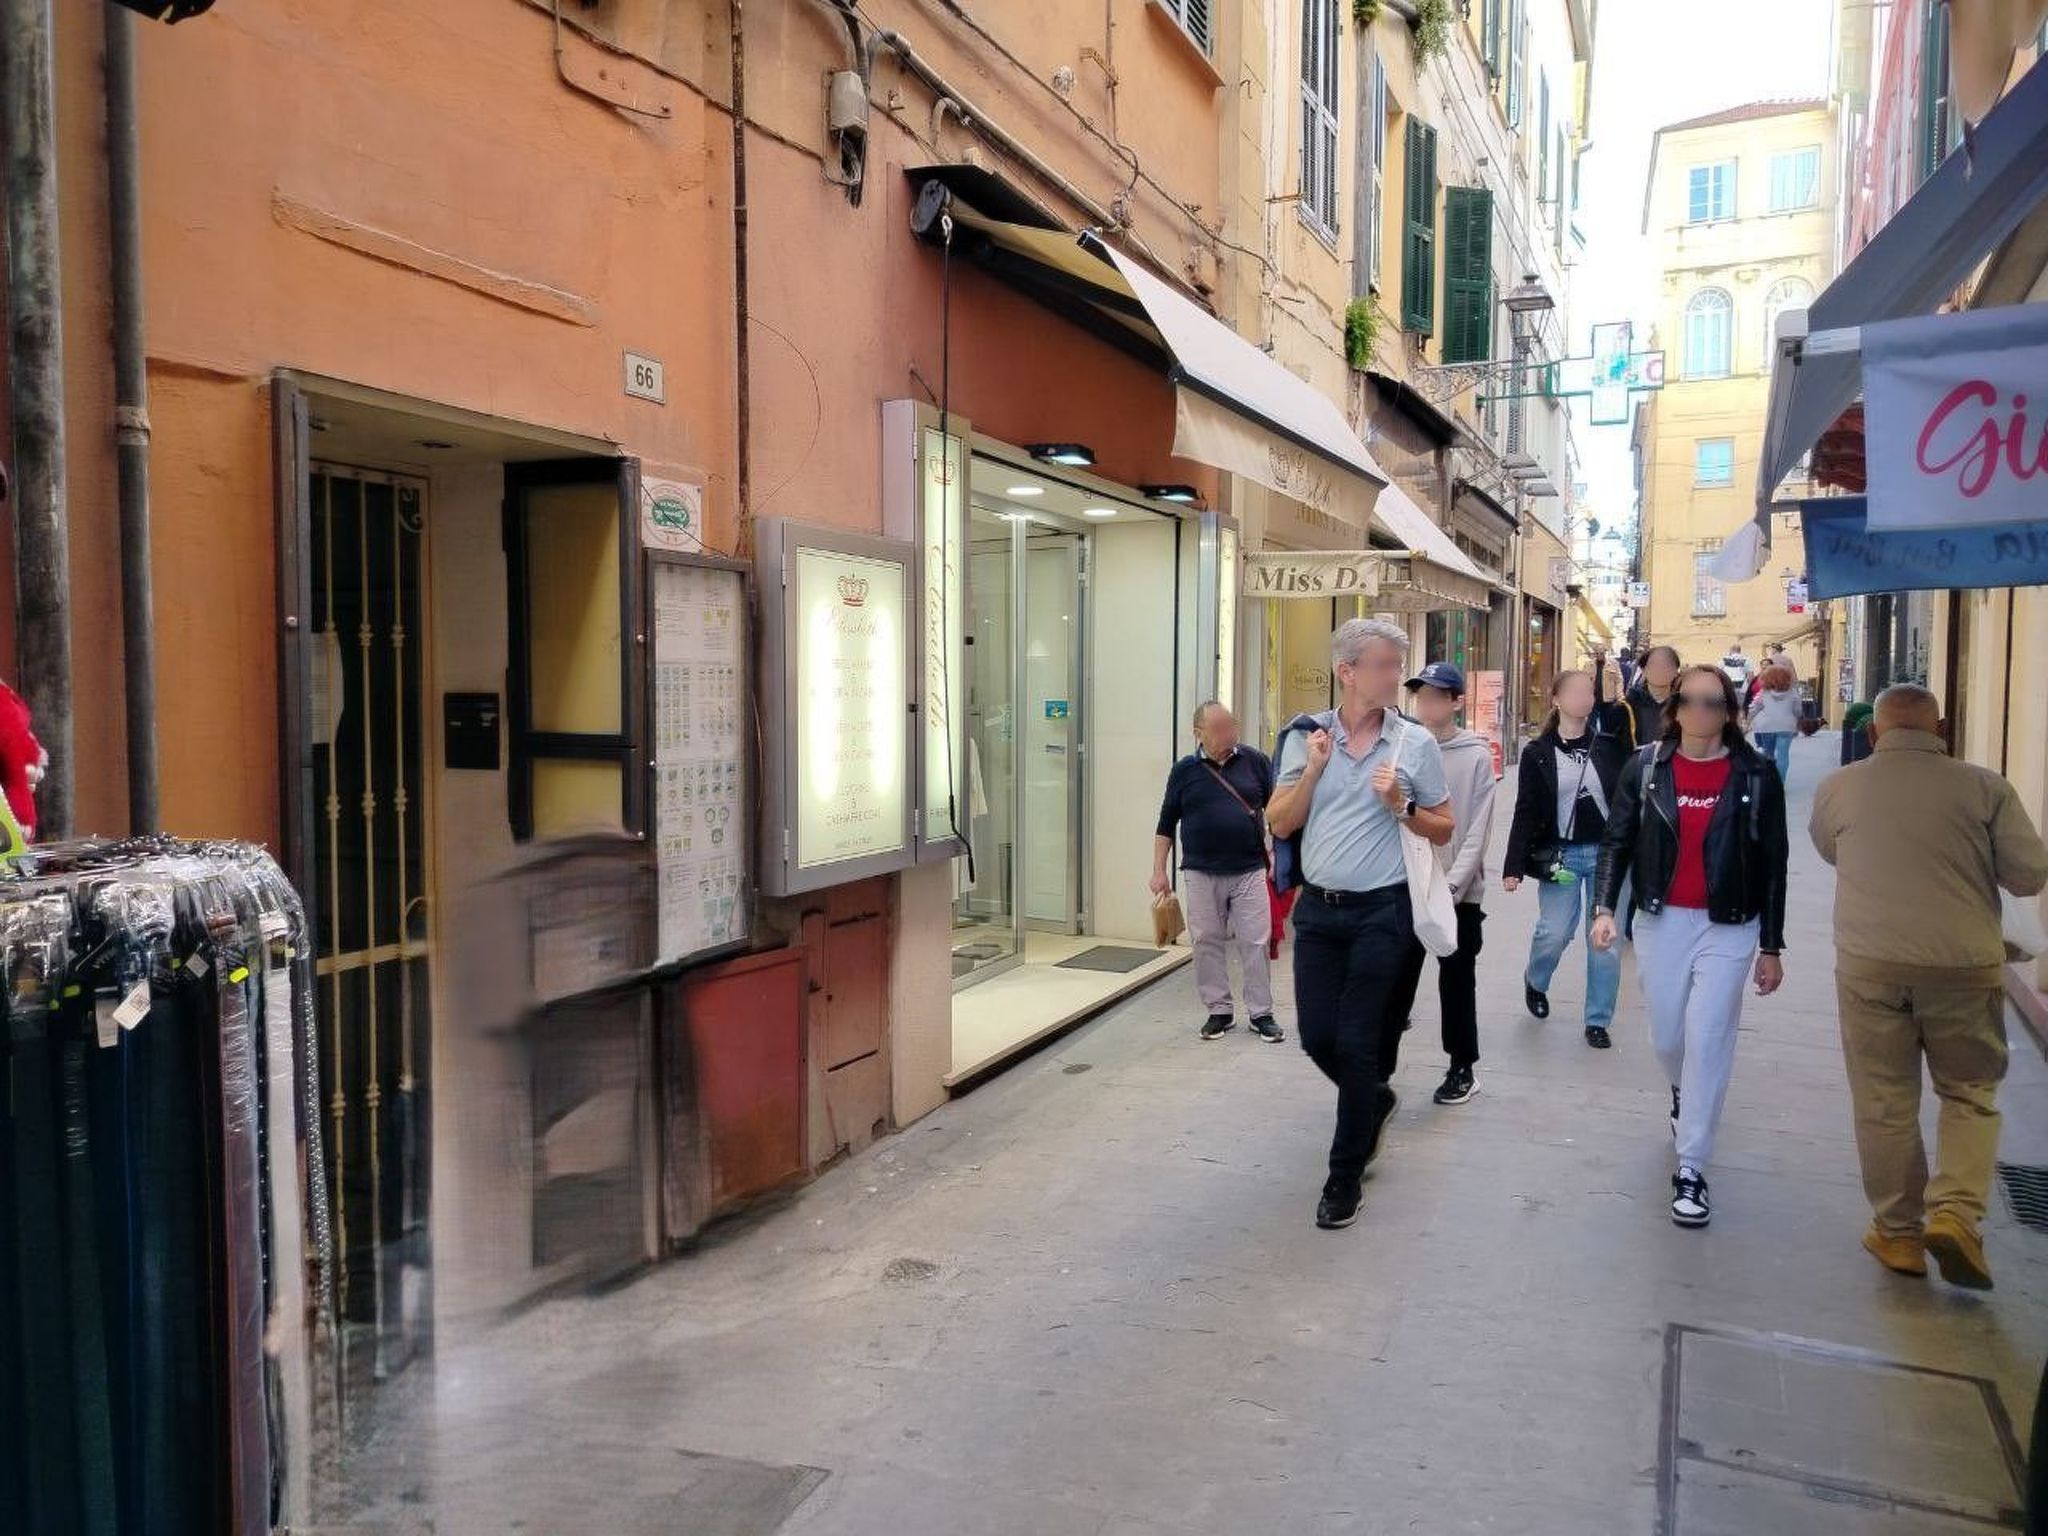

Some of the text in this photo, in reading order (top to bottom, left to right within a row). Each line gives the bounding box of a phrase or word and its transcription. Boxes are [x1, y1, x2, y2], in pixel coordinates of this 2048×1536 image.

[635, 363, 654, 390] 66
[1916, 380, 2048, 498] Gi
[1254, 566, 1368, 592] Miss D.
